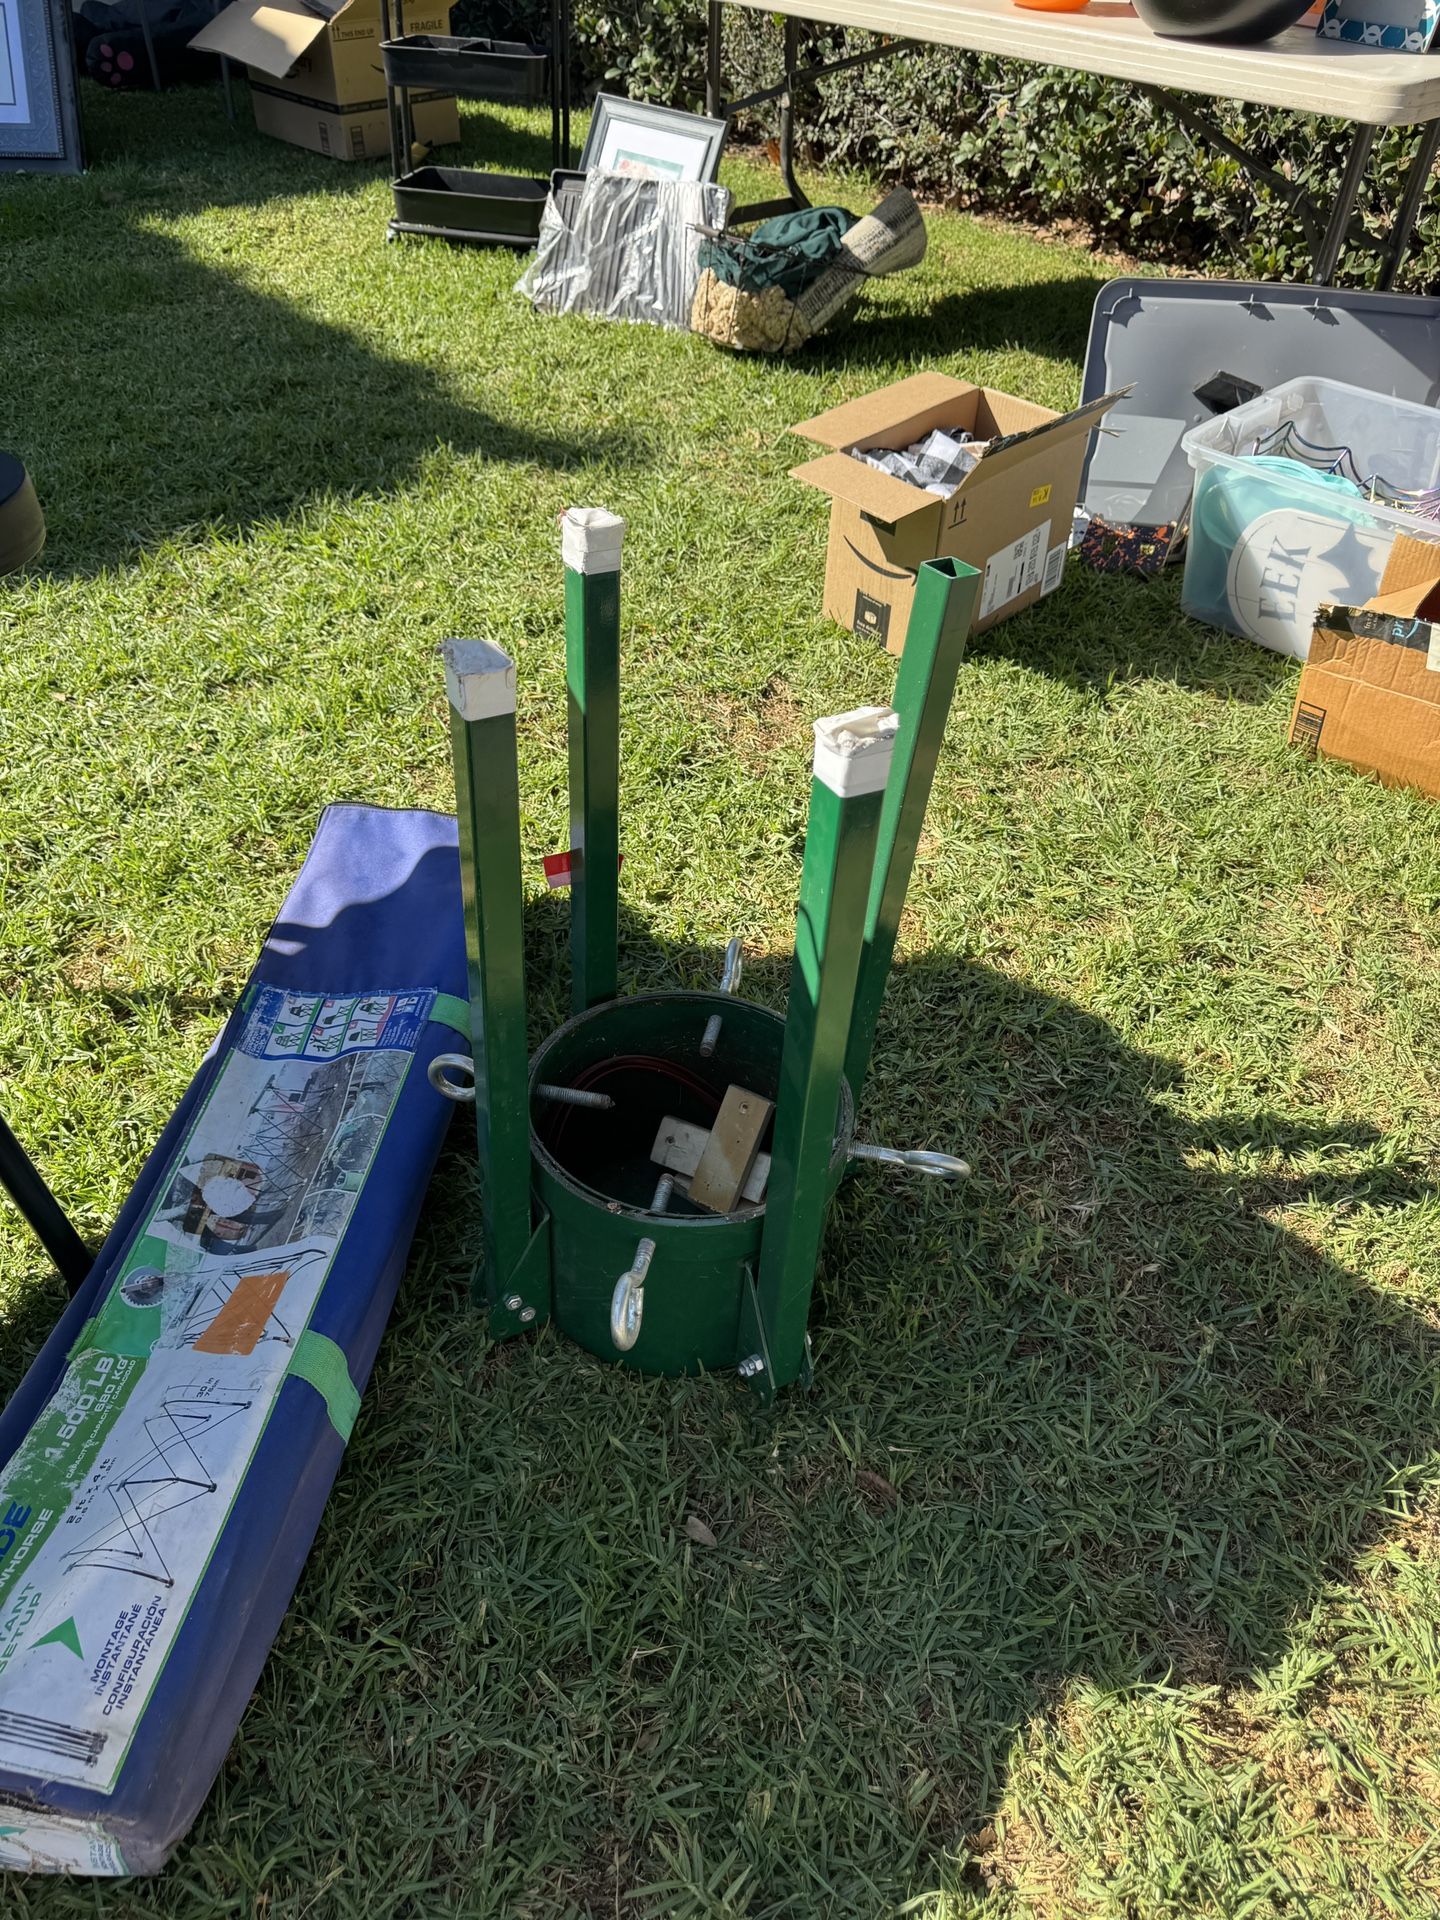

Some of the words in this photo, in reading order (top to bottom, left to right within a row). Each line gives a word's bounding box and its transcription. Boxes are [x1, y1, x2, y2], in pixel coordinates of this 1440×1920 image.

[410, 19, 443, 32] FRAGILE
[1258, 535, 1312, 624] EEK
[88, 1356, 114, 1387] LB
[94, 1384, 115, 1412] 680
[111, 1359, 129, 1380] KG
[112, 1359, 137, 1400] CAPACIDAD
[196, 1386, 208, 1398] 30
[205, 1377, 215, 1386] in
[66, 1515, 77, 1524] 2
[75, 1499, 87, 1510] ft
[93, 1475, 101, 1483] 4
[100, 1458, 111, 1469] ft
[0, 1501, 32, 1563] DE
[90, 1610, 130, 1682] MONTAGE
[94, 1603, 143, 1696] INSTANTANÉ
[102, 1595, 162, 1716] CONFIGURACIÓN
[115, 1607, 168, 1710] INSTANTÁNEA
